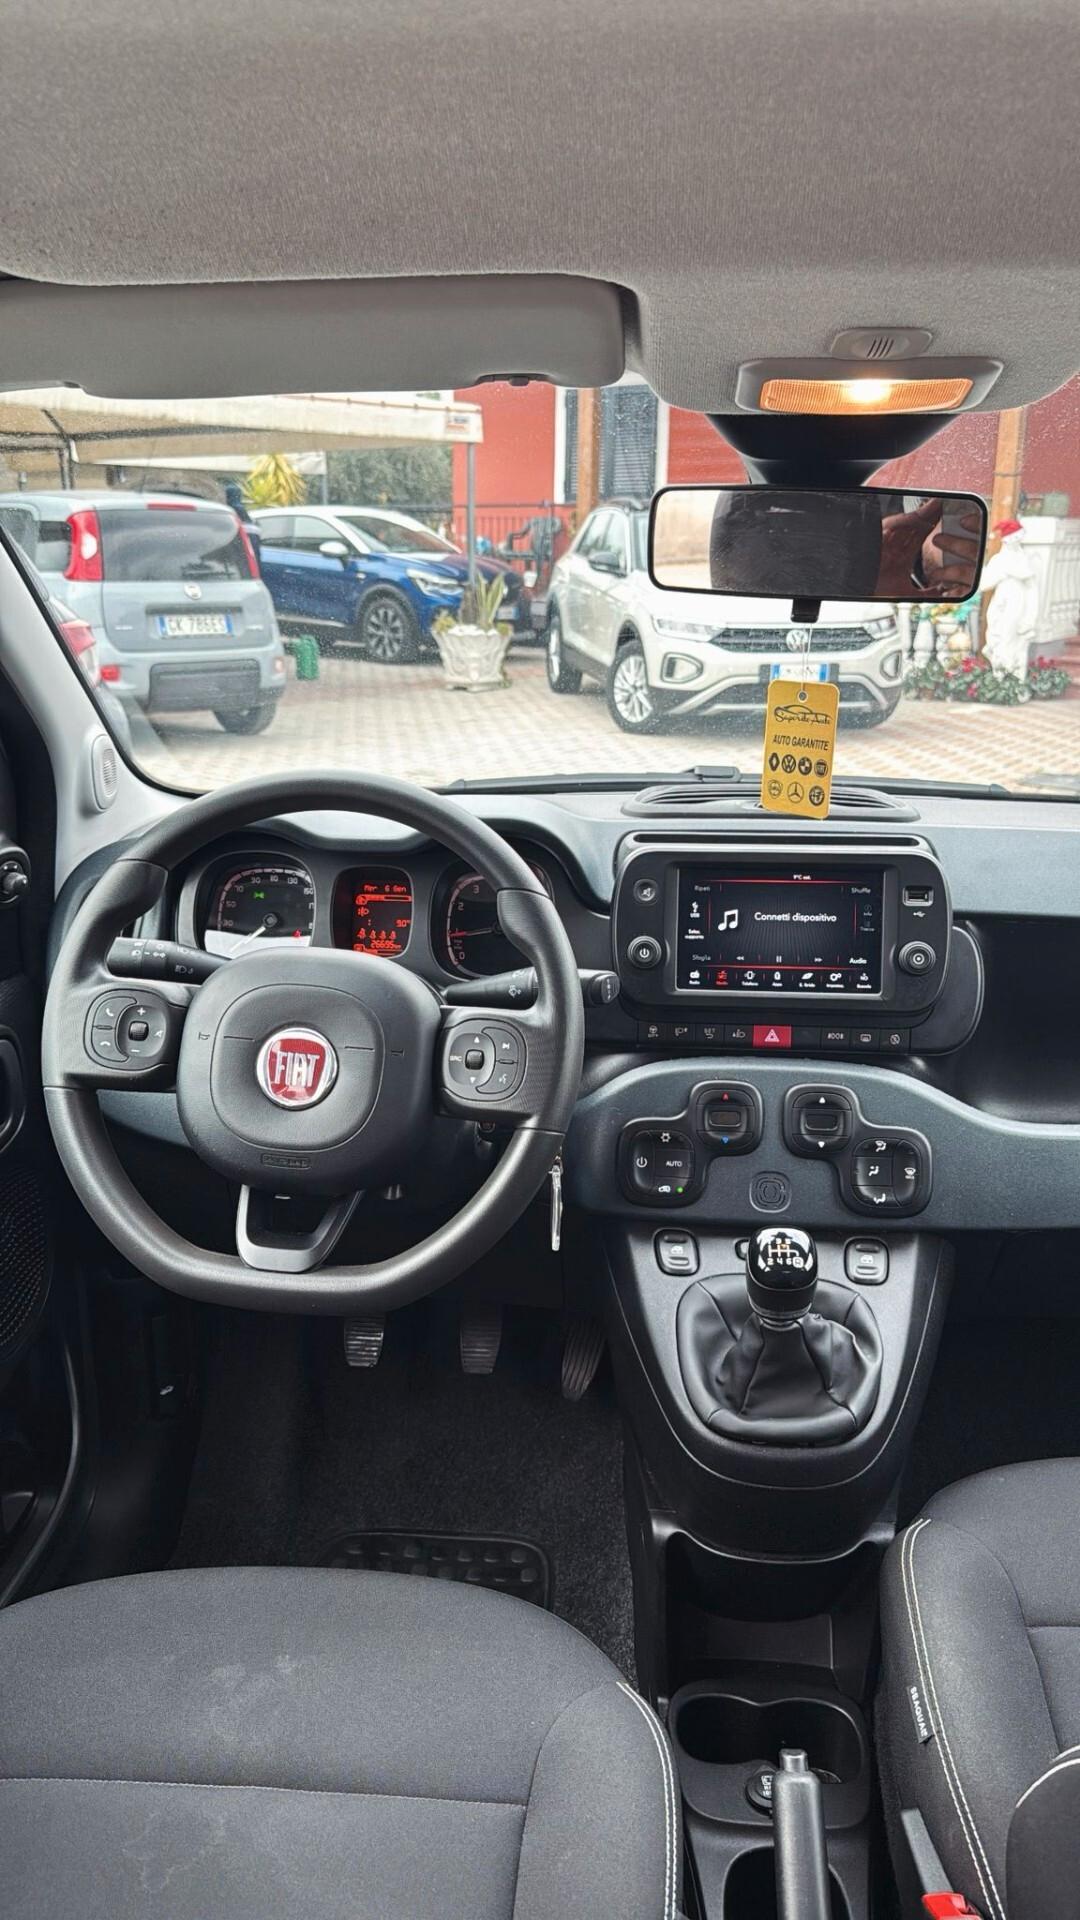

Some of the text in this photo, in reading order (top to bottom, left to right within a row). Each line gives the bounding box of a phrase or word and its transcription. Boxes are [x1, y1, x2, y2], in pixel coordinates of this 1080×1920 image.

[772, 735, 830, 751] AUTO GARANTITE
[288, 877, 299, 885] 130
[473, 885, 480, 894] 3
[457, 902, 465, 911] 2
[754, 912, 837, 923] Connetti dispositivo
[459, 951, 466, 960] 0
[274, 1050, 321, 1088] FIAT
[767, 1257, 774, 1266] 2
[776, 1257, 784, 1266] 4
[786, 1257, 792, 1266] 6
